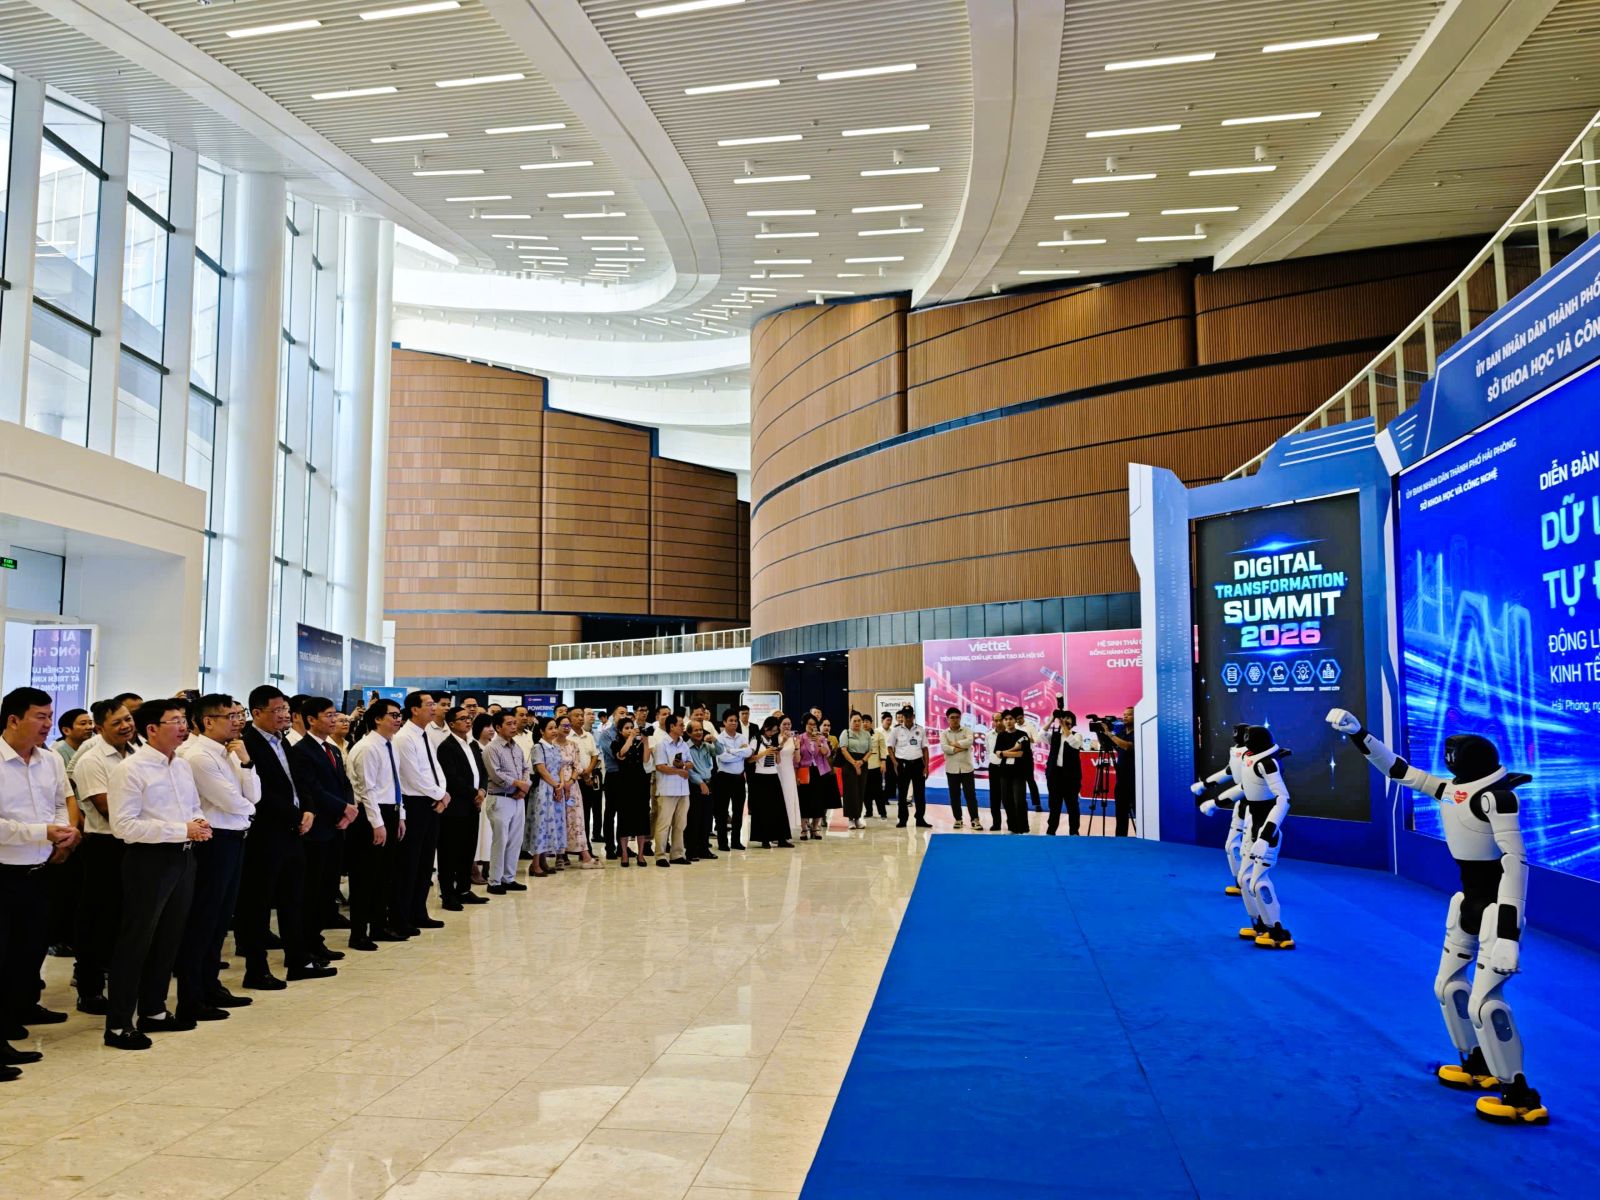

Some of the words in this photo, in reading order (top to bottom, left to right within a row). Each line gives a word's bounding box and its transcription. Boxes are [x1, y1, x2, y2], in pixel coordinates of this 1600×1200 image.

[1476, 359, 1485, 378] ỦY
[1486, 349, 1501, 372] BAN
[1502, 334, 1527, 360] NHÂN
[1528, 320, 1547, 344] DÂN
[1547, 295, 1579, 329] THÀNH
[1487, 376, 1500, 402] SỞ
[1501, 364, 1529, 394] KHOA
[1531, 348, 1555, 376] HỌC
[1556, 332, 1573, 360] VÀ
[1412, 484, 1423, 496] BAN
[1422, 476, 1438, 490] NHÂN
[1437, 471, 1450, 484] DÂN
[1449, 464, 1469, 479] THÀNH
[1468, 452, 1482, 469] PHỐ
[1481, 447, 1493, 462] HẢI
[1493, 437, 1517, 456] PHÒNG
[1539, 459, 1569, 491] DIỄN
[1571, 450, 1600, 478] ĐÀN
[1420, 499, 1428, 511] SỞ
[1427, 495, 1443, 508] KHOA
[1442, 489, 1455, 501] HỌC
[1455, 483, 1464, 495] VÀ
[1463, 478, 1480, 492] CÔNG
[1480, 467, 1498, 484] NGHỆ
[1541, 493, 1585, 550] DỮ
[1233, 550, 1322, 580] DIGITAL
[1214, 571, 1345, 599] TRANSFORMATION
[1542, 563, 1586, 617] TỰ
[1223, 590, 1341, 624] SUMMIT
[968, 640, 1012, 653] viettel
[1240, 621, 1321, 648] 2026
[1549, 627, 1587, 656] ĐỘNG
[1590, 628, 1600, 649] L
[1550, 663, 1582, 683] KINH
